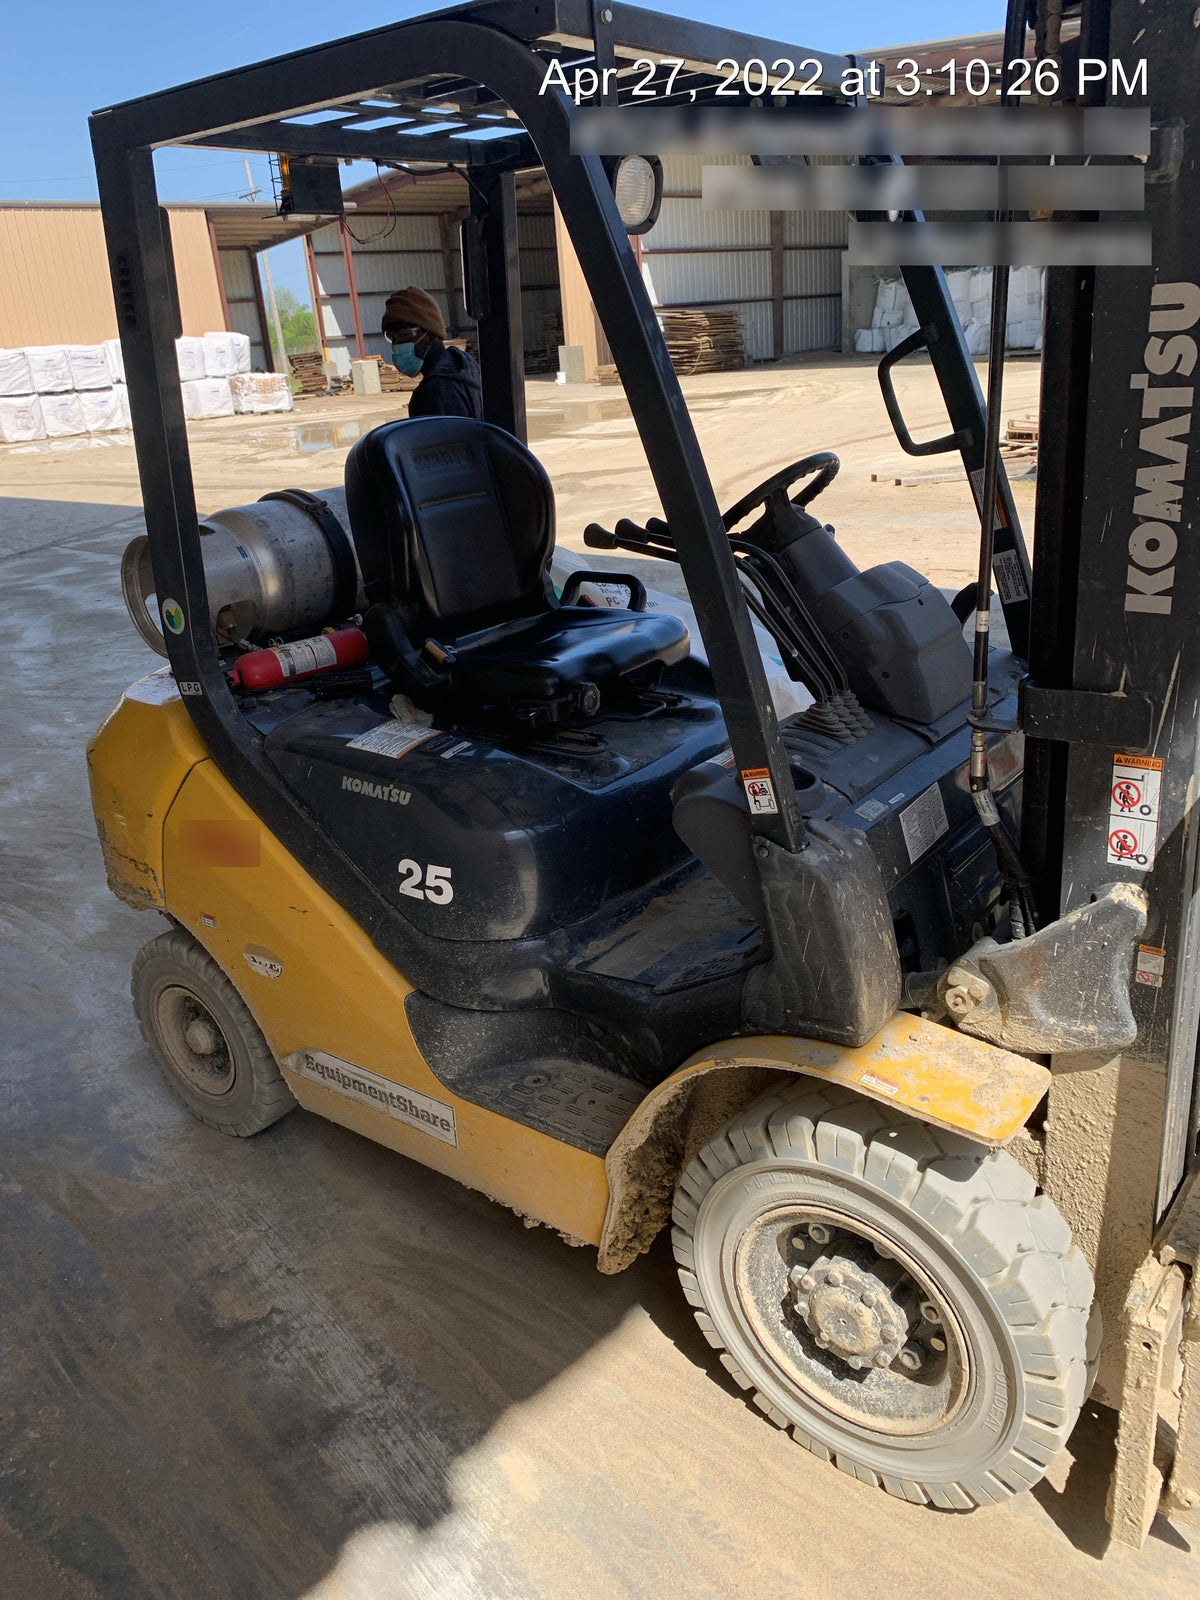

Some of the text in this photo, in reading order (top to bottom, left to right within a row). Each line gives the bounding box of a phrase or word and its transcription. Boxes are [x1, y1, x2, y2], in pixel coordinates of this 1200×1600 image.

[1124, 281, 1200, 615] KOMATSU
[179, 681, 201, 694] LPG
[1123, 757, 1161, 768] WARNING
[341, 775, 412, 806] KOMATSU
[398, 858, 454, 905] 25
[304, 1053, 451, 1132] EquipmentShare
